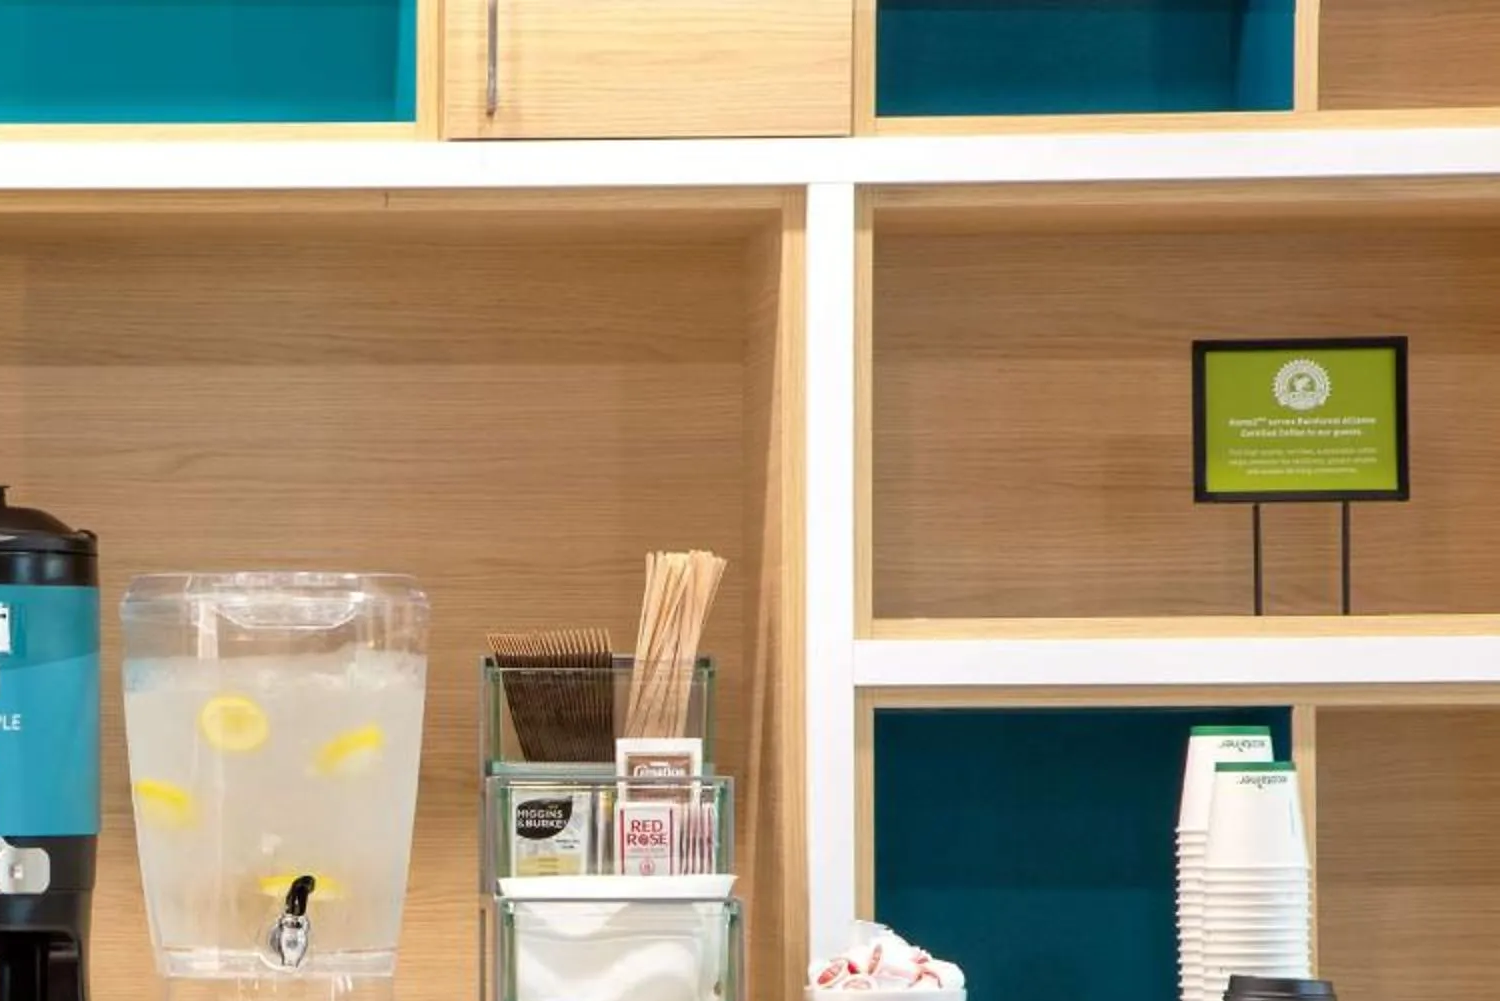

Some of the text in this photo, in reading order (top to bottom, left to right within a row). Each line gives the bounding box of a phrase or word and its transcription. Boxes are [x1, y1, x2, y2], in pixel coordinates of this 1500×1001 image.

[517, 809, 564, 819] HIGGINS
[631, 819, 664, 833] RED
[627, 833, 668, 846] ROSE
